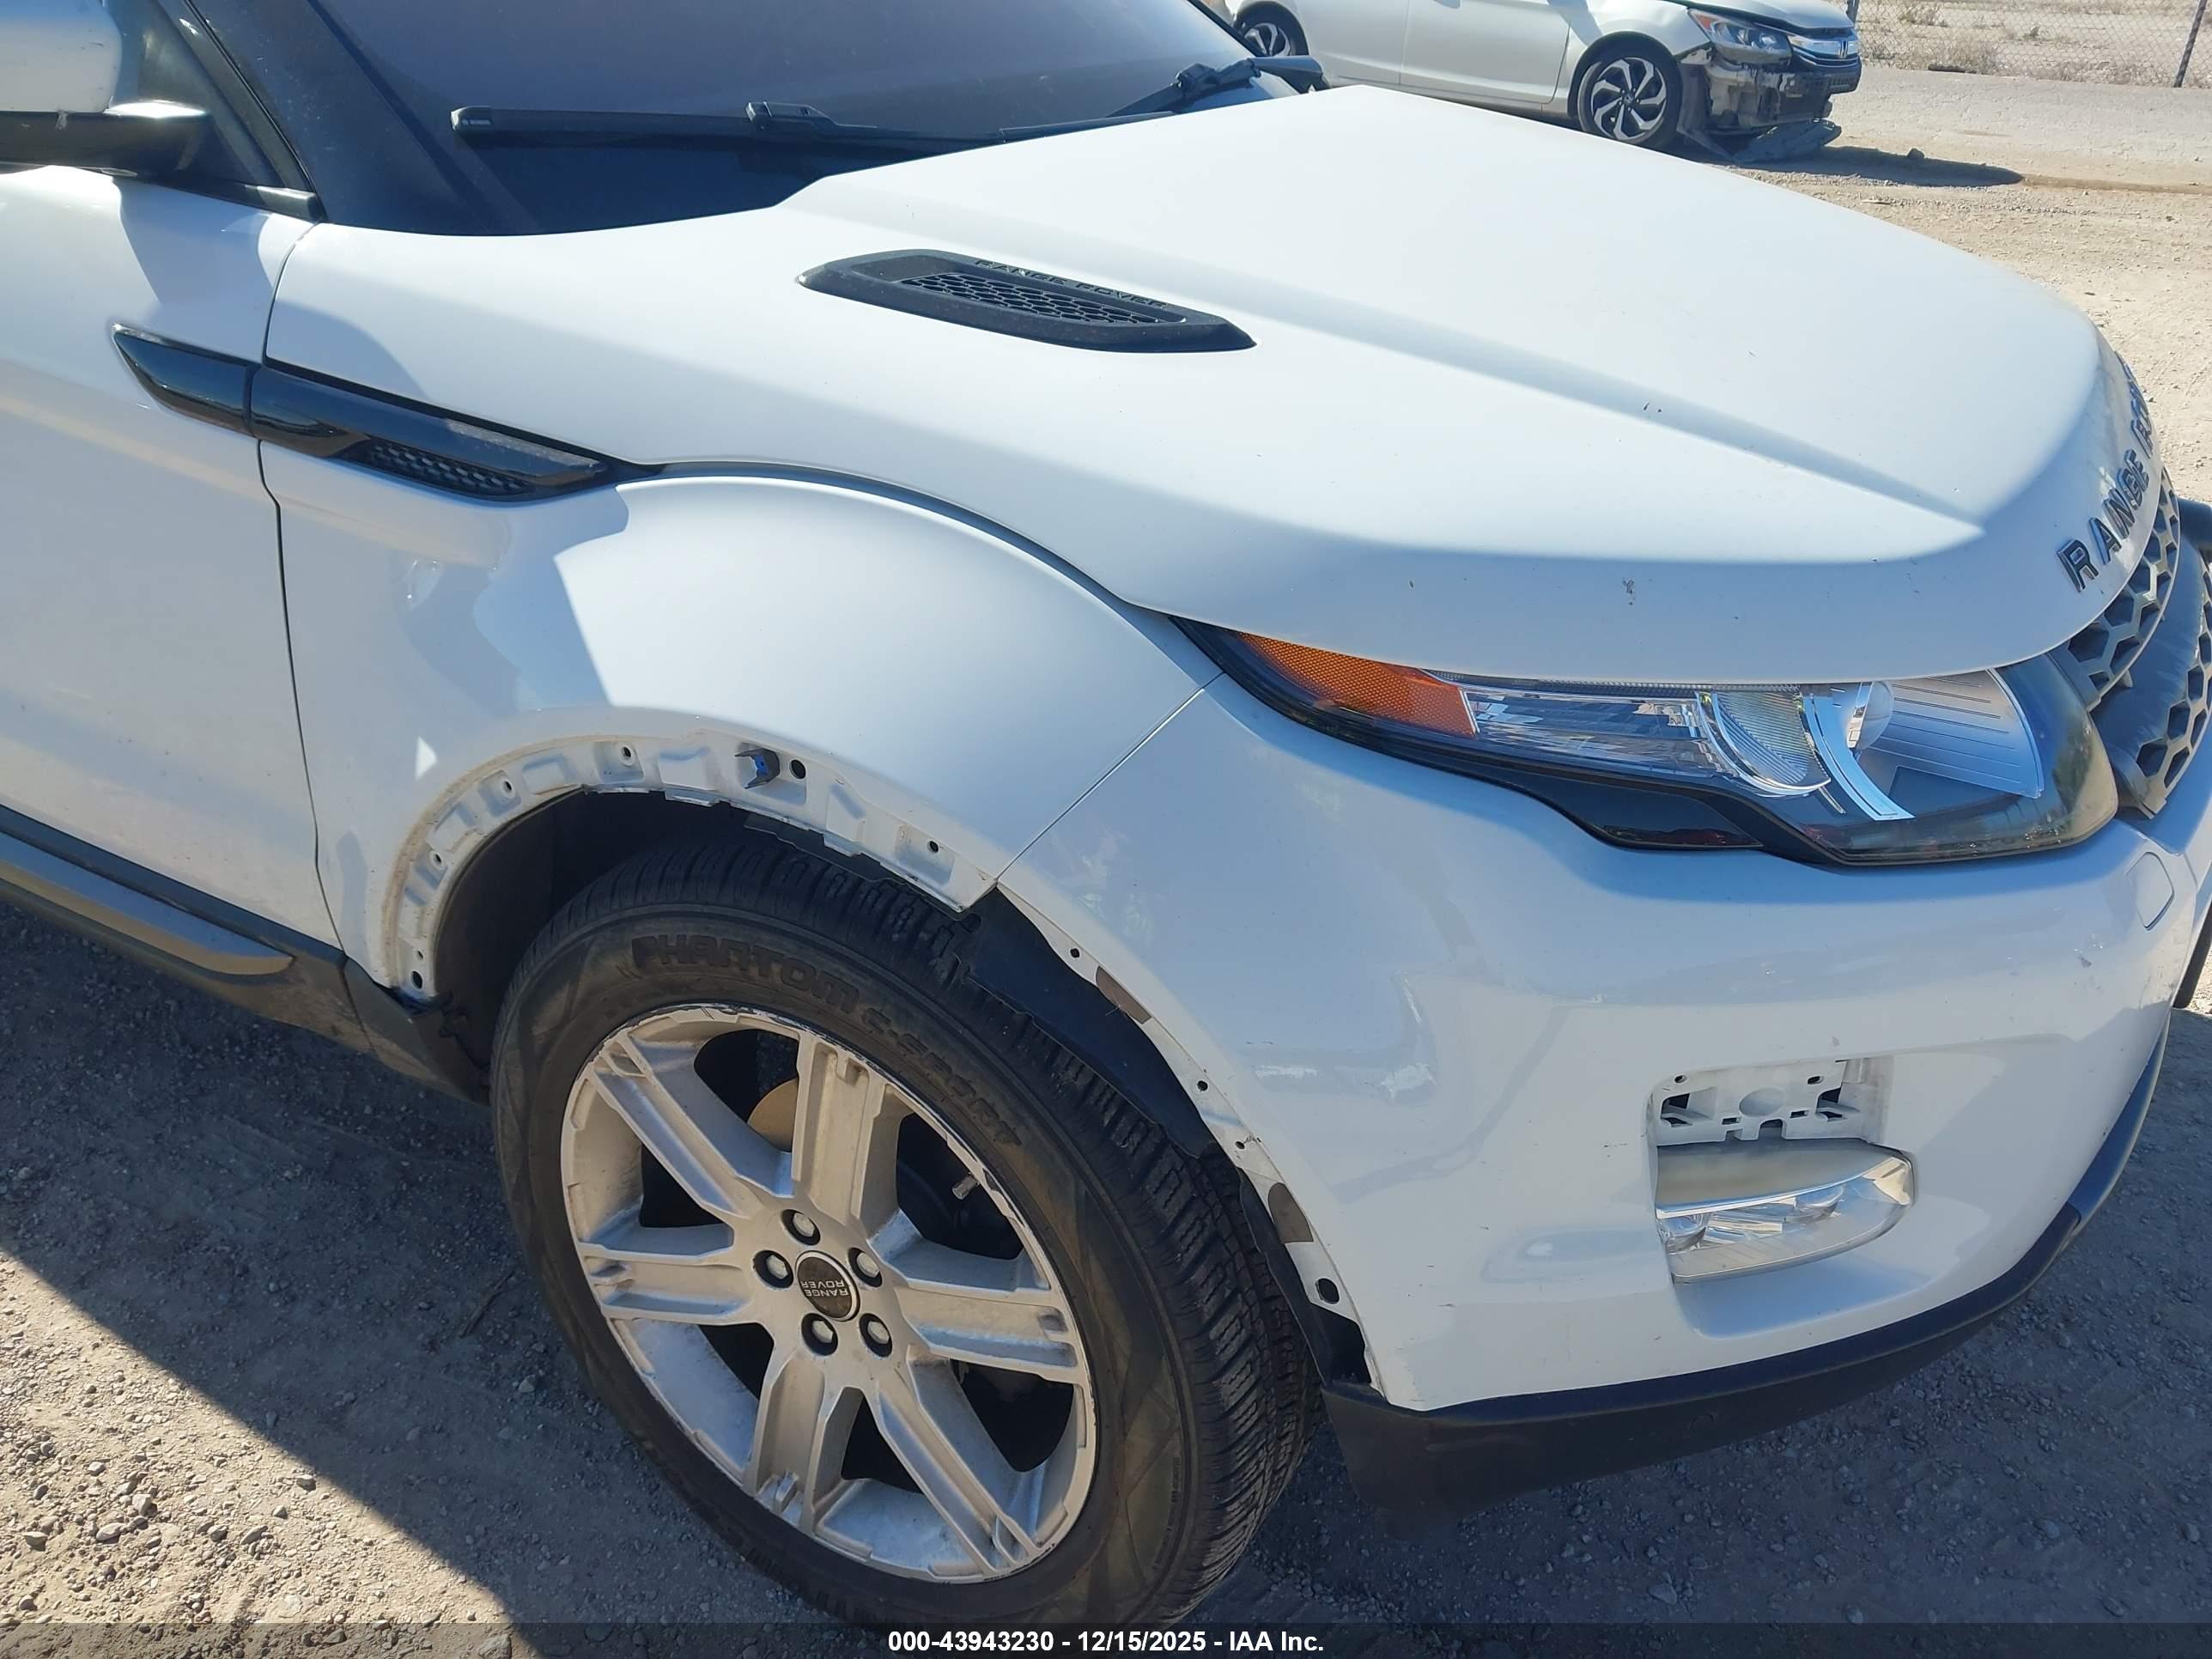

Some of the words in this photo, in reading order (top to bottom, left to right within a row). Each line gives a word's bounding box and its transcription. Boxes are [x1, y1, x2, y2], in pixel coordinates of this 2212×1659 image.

[975, 259, 1067, 285] RANGE
[1076, 282, 1168, 308] ROVER
[2057, 448, 2150, 592] RANGE
[632, 934, 860, 1014] PHANTOM
[800, 1279, 845, 1289] ROVER
[805, 1288, 849, 1297] RANGE
